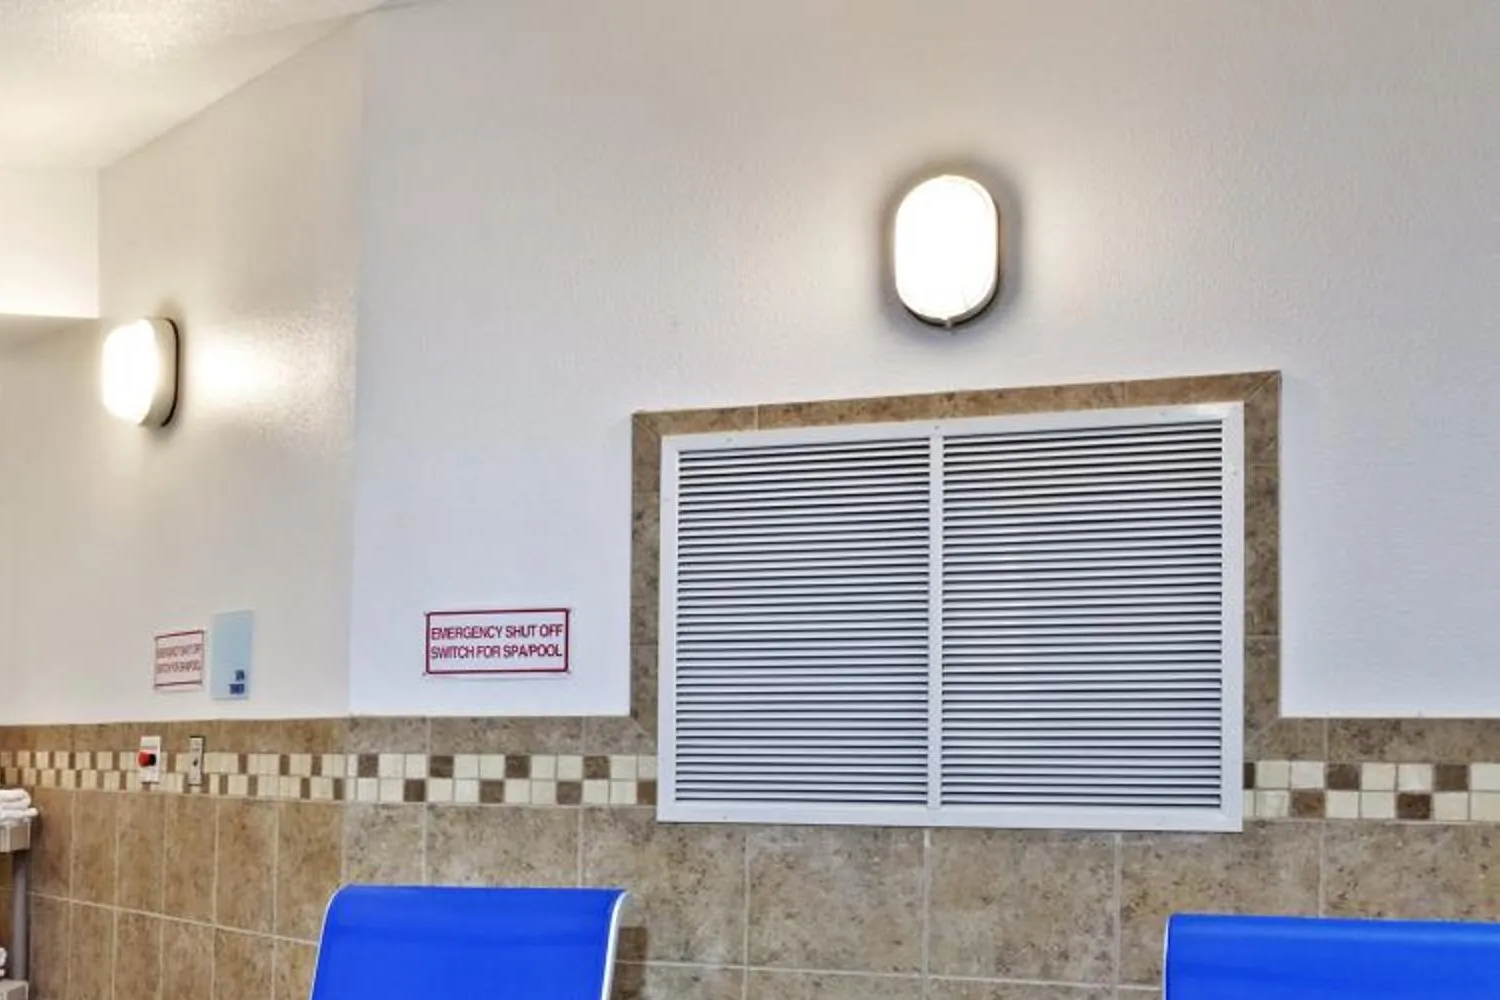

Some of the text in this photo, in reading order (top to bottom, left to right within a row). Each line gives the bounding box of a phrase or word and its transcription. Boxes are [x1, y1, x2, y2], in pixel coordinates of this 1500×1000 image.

[431, 624, 563, 640] EMERGENCY SHUT OFF
[431, 645, 474, 659] SWITCH
[476, 645, 500, 658] FOR
